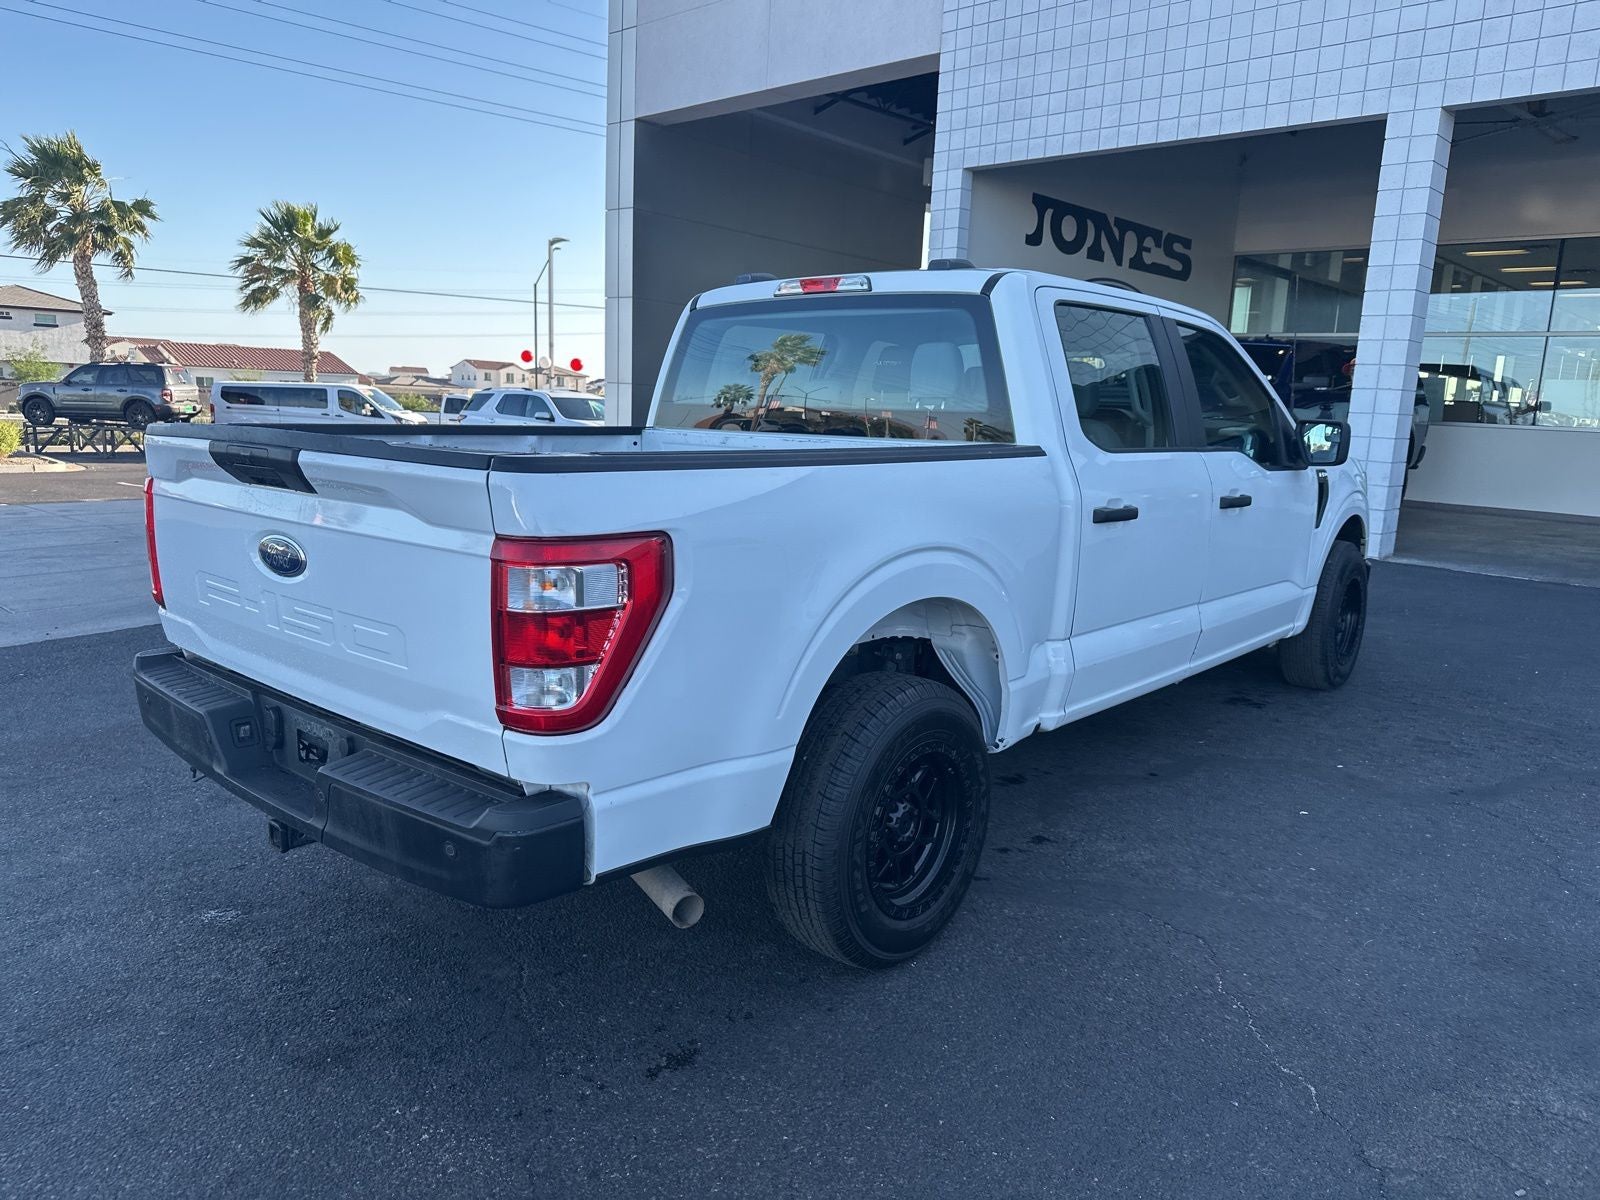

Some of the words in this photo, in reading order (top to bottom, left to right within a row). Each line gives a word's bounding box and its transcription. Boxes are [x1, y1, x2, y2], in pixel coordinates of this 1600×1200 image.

[1025, 192, 1192, 281] JONES
[264, 541, 293, 570] Ford
[195, 569, 409, 670] F-150
